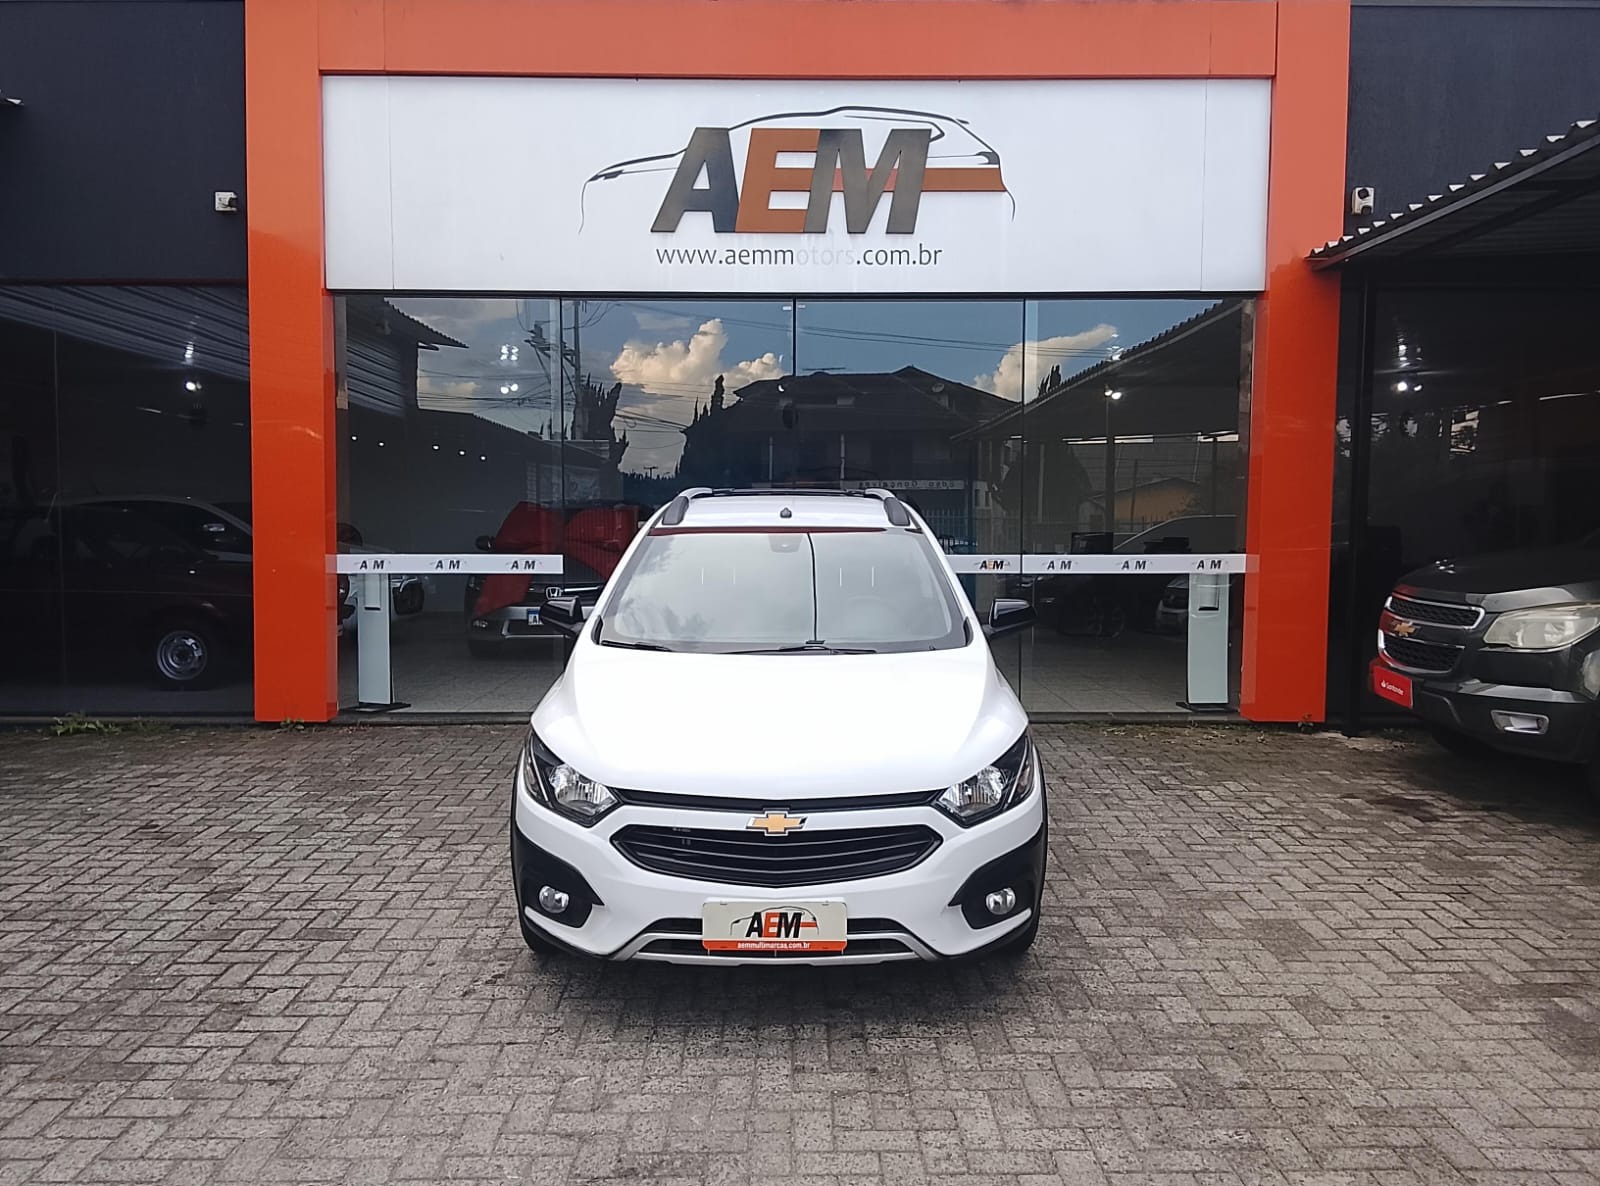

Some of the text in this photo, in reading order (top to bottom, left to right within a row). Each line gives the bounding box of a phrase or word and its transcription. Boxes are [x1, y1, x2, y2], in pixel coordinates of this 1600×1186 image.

[650, 126, 932, 234] AEM
[656, 243, 942, 266] www.aemmotors.com.br
[979, 560, 1004, 570] AEM
[745, 912, 803, 938] AEM
